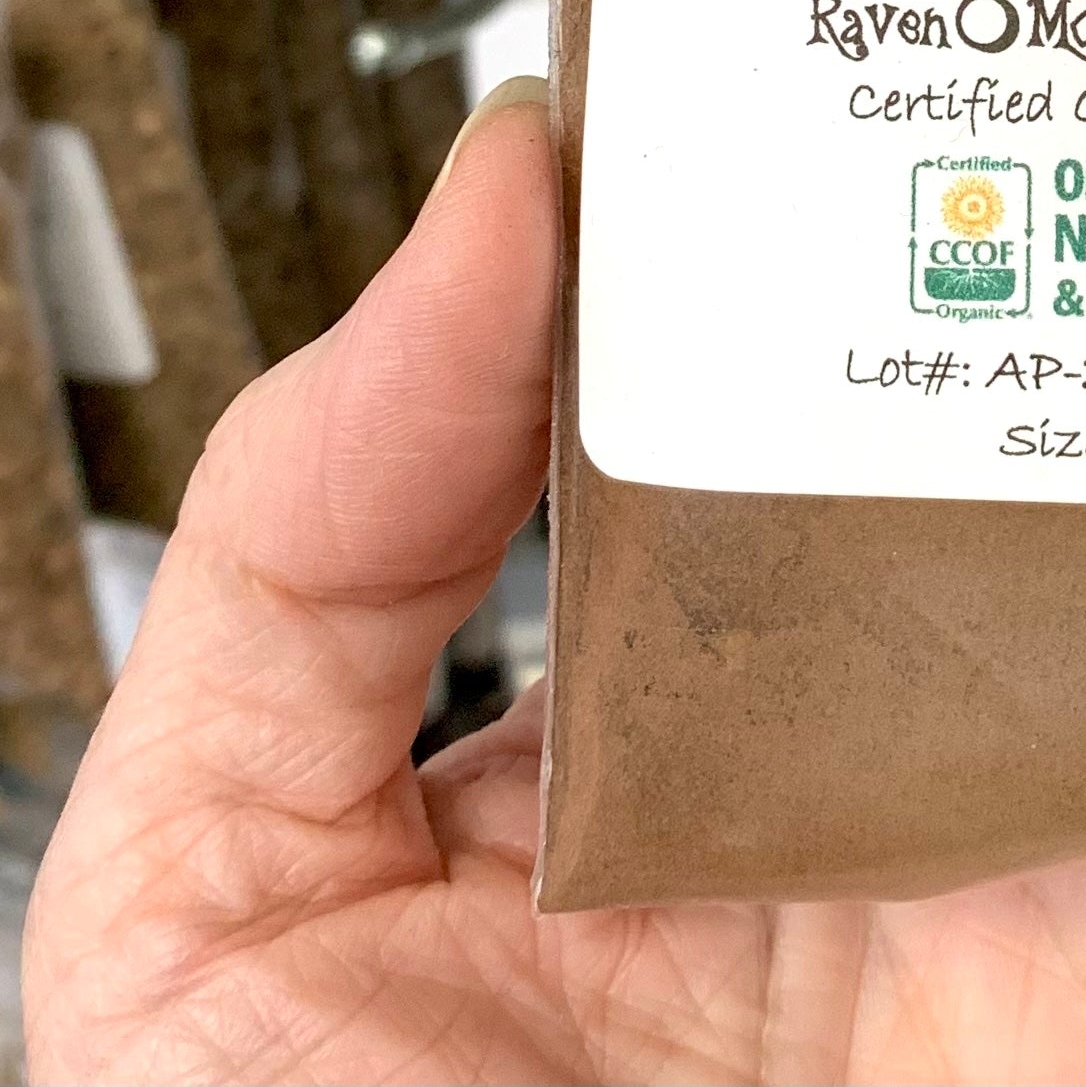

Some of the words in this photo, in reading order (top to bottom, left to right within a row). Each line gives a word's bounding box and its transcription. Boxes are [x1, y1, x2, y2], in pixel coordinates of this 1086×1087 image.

[849, 76, 1054, 137] Certified
[936, 155, 1012, 172] Certified
[929, 239, 1015, 267] CCOF
[935, 303, 1004, 324] Organic
[1053, 279, 1085, 317] &
[846, 349, 971, 396] Lot#:
